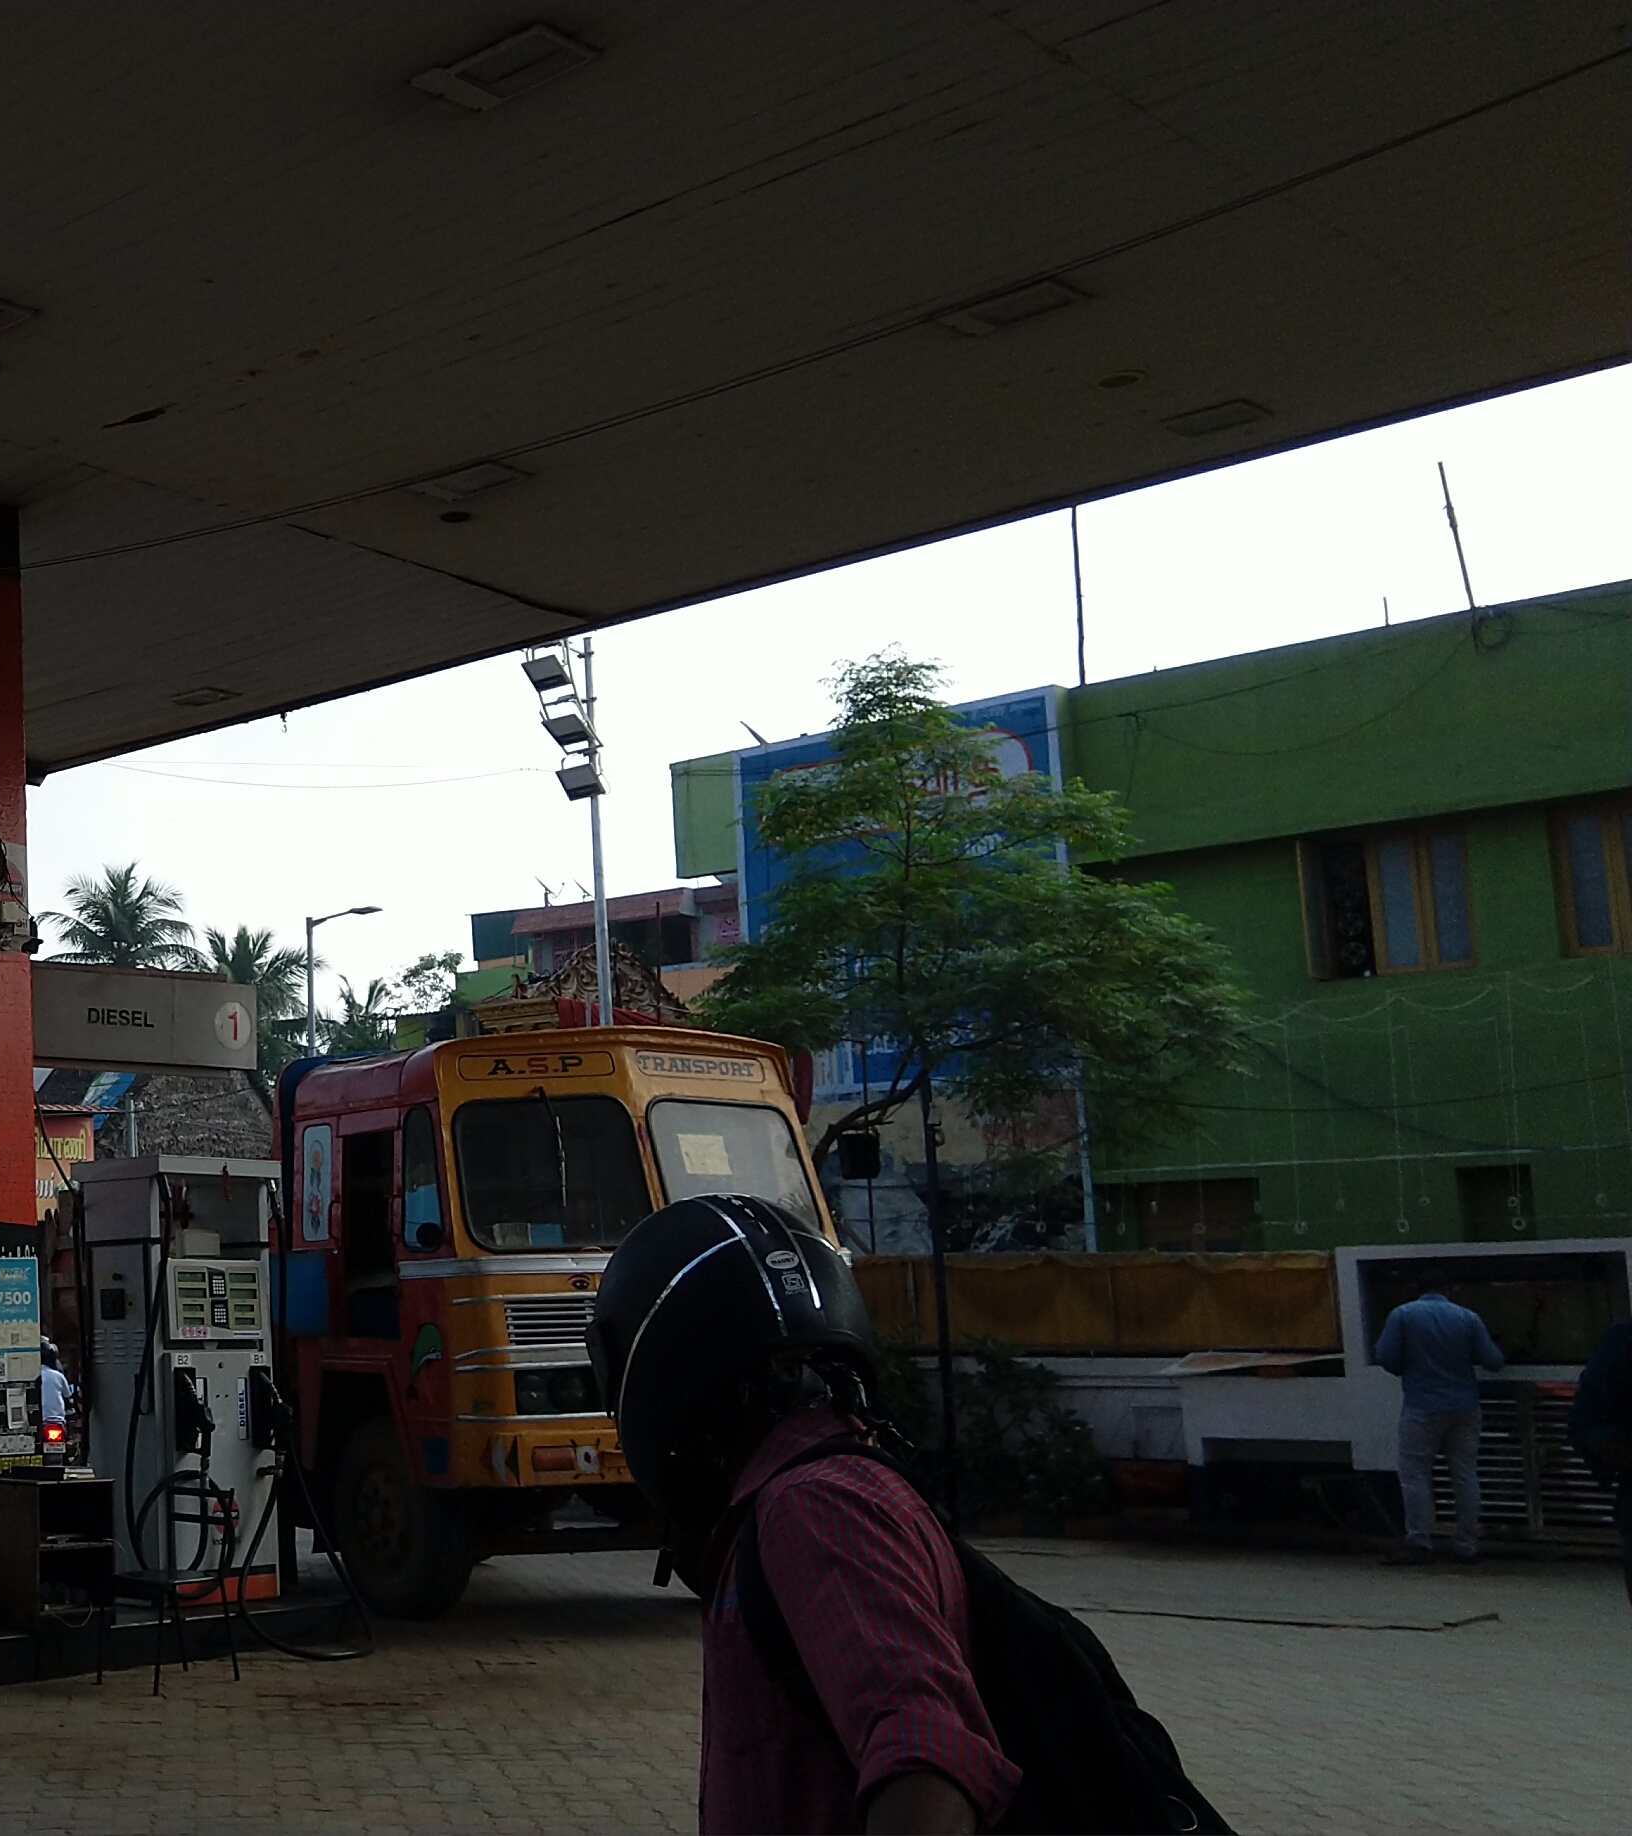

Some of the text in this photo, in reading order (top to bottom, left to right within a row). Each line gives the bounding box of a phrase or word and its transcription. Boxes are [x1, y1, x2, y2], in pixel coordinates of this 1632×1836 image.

[87, 1007, 155, 1029] DIESEL
[227, 1011, 240, 1042] 1
[488, 1055, 754, 1078] A.S.P TRANSPORT
[177, 1355, 189, 1365] B2
[254, 1355, 264, 1364] B1
[238, 1390, 246, 1427] DIESEL
